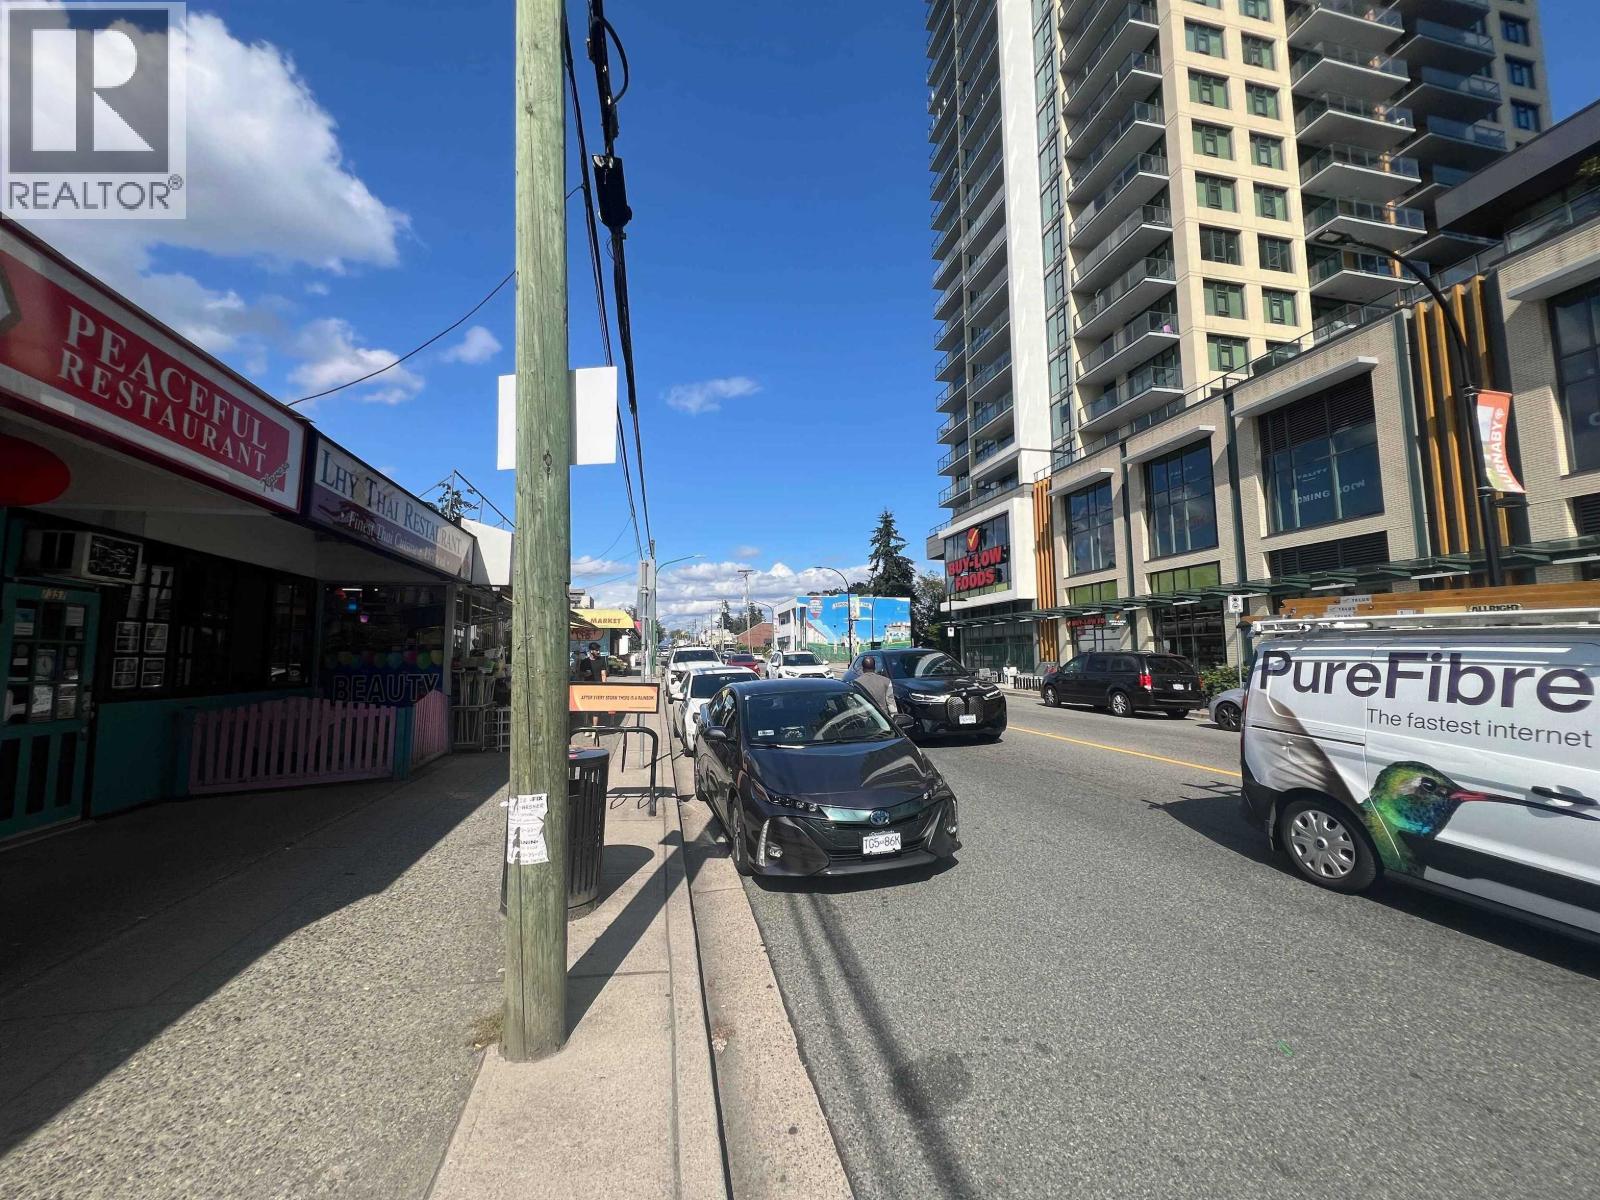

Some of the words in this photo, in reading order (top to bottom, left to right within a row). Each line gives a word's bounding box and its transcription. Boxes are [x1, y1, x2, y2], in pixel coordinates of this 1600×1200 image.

[65, 306, 268, 449] PEACEFUL
[58, 347, 266, 473] RESTAURANT
[320, 449, 359, 499] LHY
[366, 477, 399, 521] THAI
[1293, 490, 1331, 504] OMING
[947, 546, 1003, 577] BUY-LOW
[955, 569, 996, 592] FOODS
[332, 673, 440, 703] BEAUTY
[1259, 650, 1595, 714] PureFibre
[1368, 708, 1402, 726] The
[1407, 711, 1481, 736] fastest
[1488, 720, 1593, 748] internet
